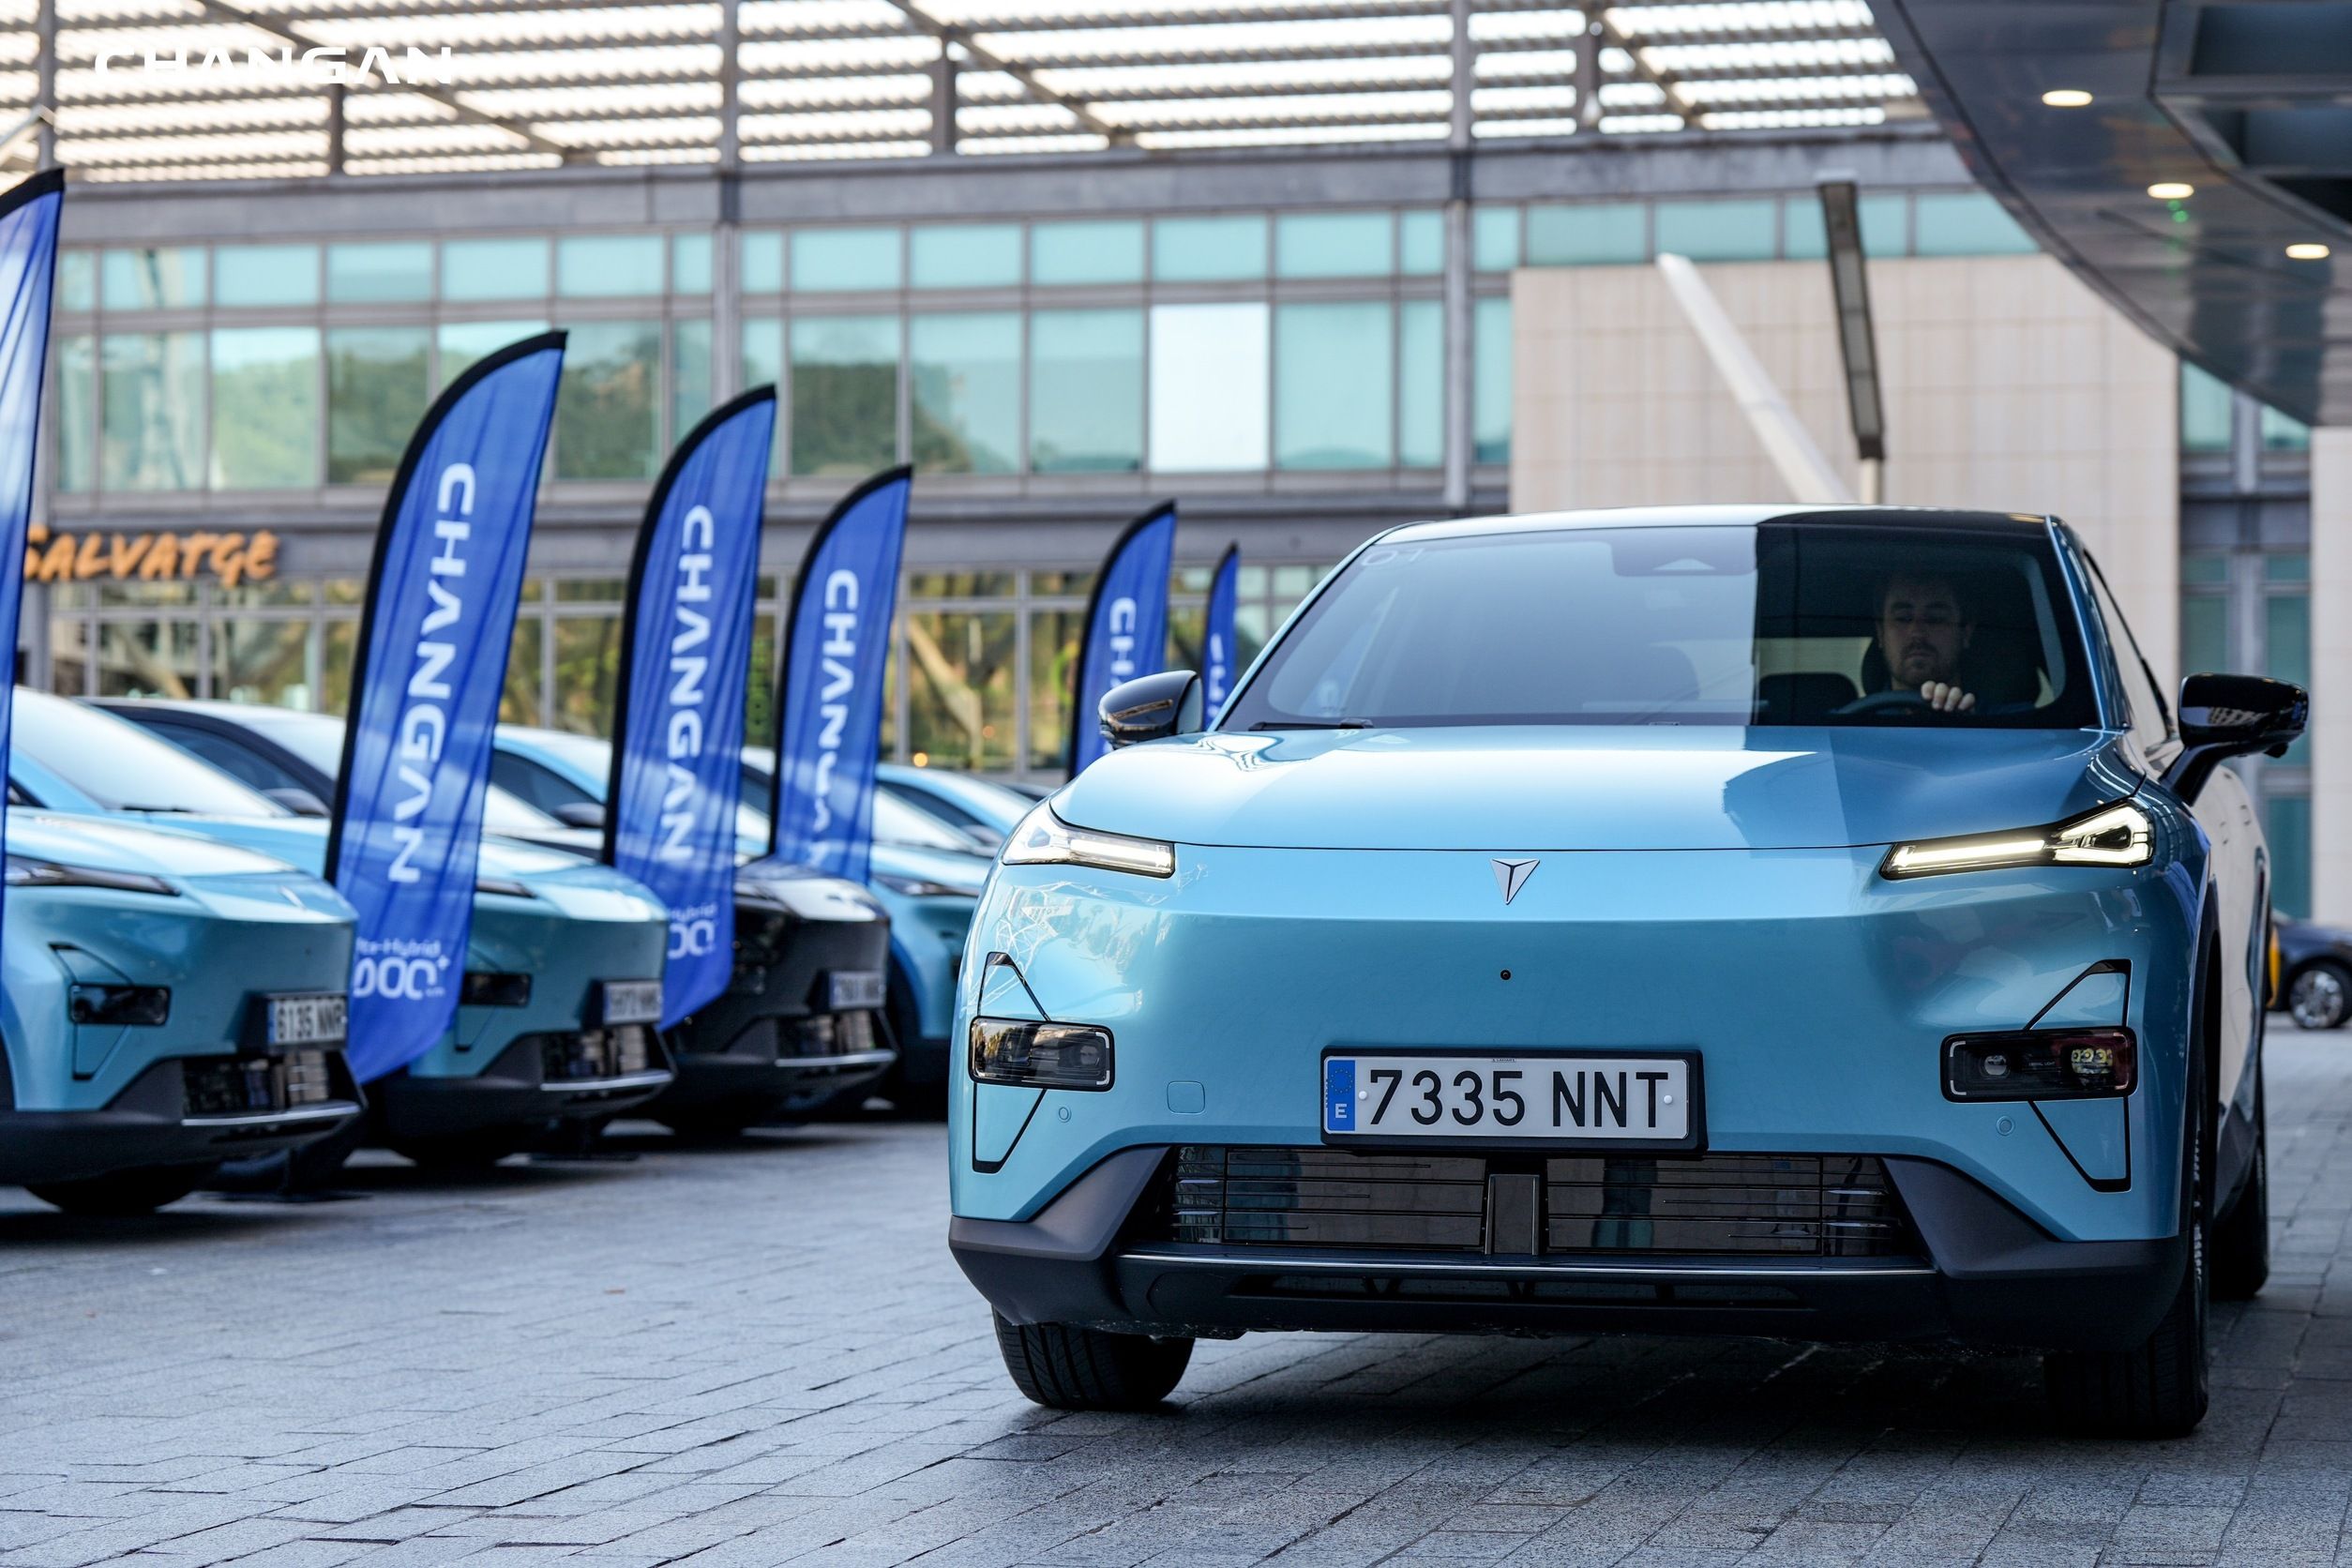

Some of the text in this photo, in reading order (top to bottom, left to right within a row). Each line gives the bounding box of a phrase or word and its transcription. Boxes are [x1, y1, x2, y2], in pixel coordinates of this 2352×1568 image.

[387, 462, 476, 883] CHANGAN
[660, 505, 715, 863] CHANGAN
[1334, 1103, 1348, 1119] E
[1370, 1069, 1525, 1126] 7335
[1553, 1071, 1668, 1128] NNT
